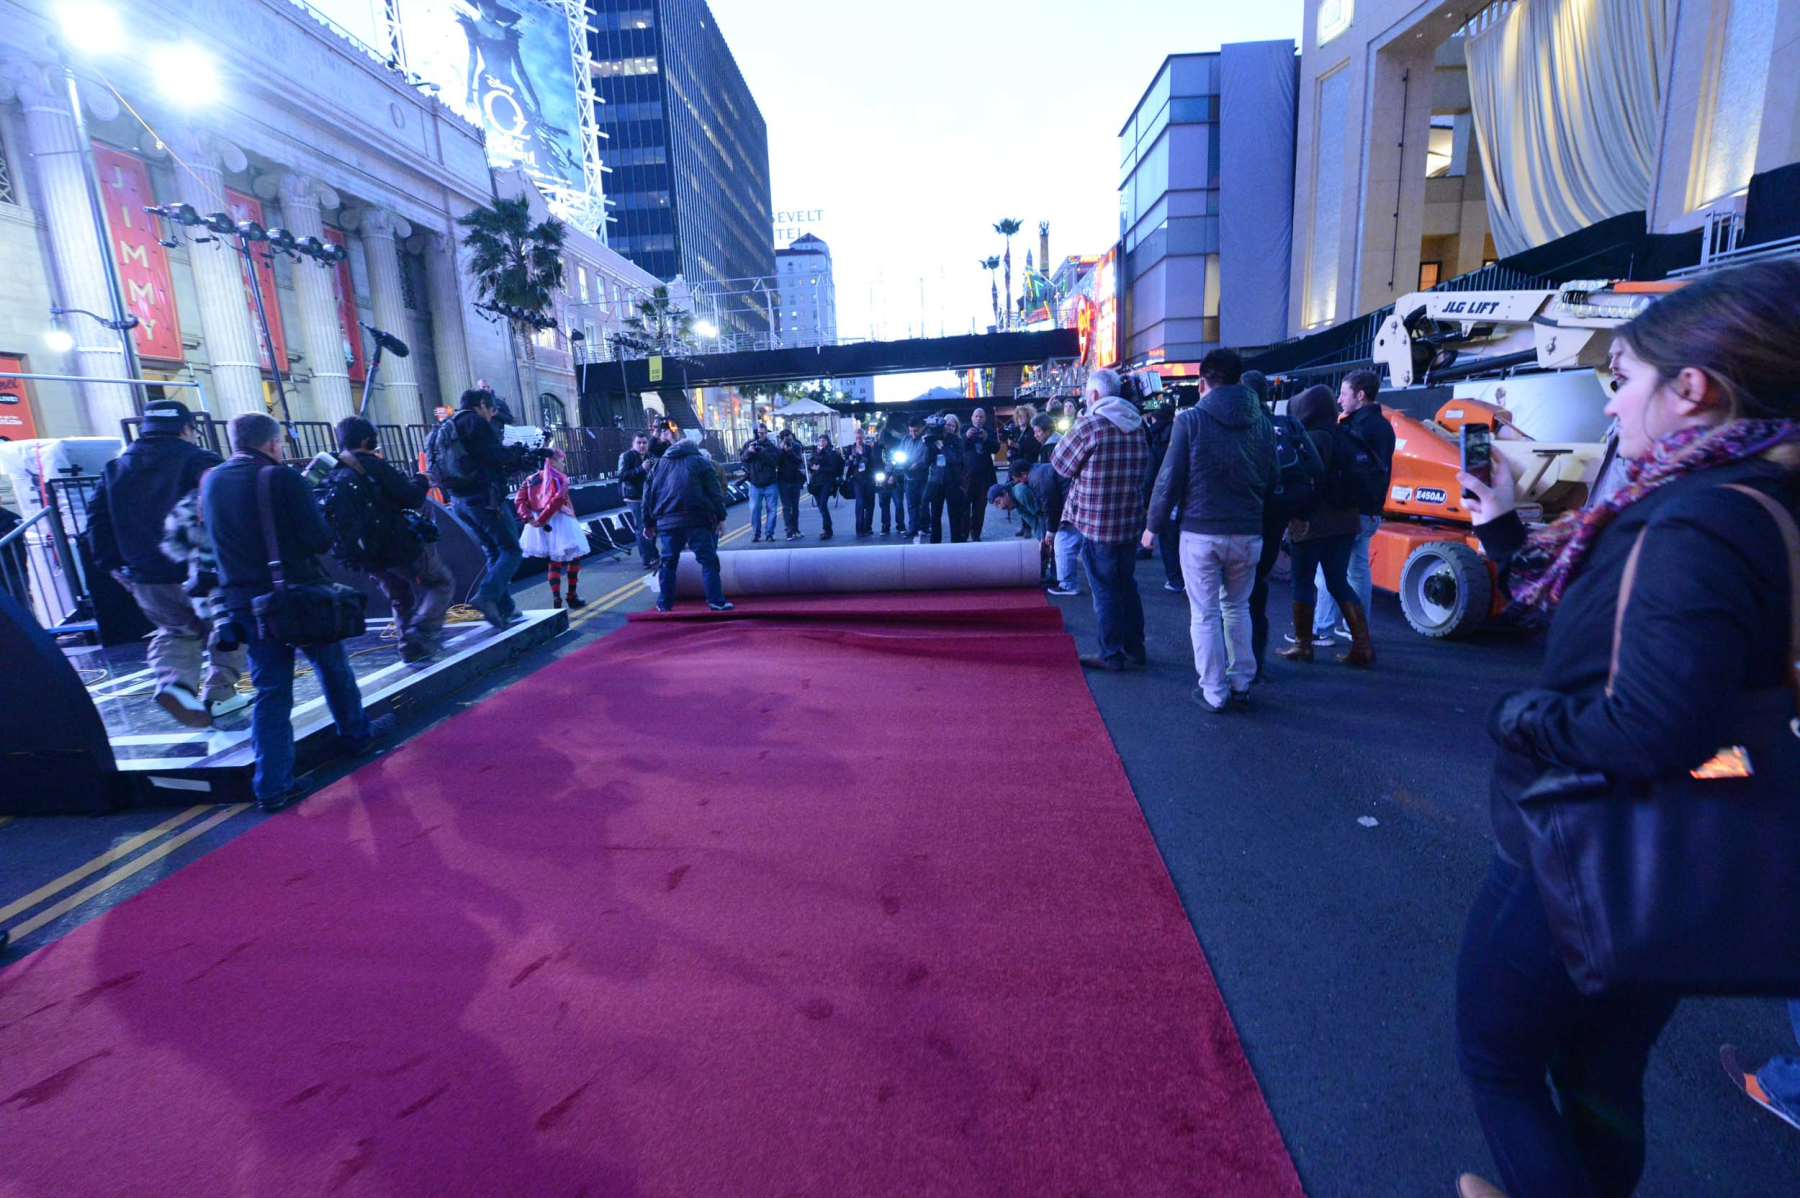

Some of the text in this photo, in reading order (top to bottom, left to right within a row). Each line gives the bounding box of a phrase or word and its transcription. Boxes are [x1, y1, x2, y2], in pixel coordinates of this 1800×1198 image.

[111, 166, 156, 341] JIMMY
[1441, 301, 1500, 314] JLG LIFT
[1416, 490, 1446, 502] E450AJ
